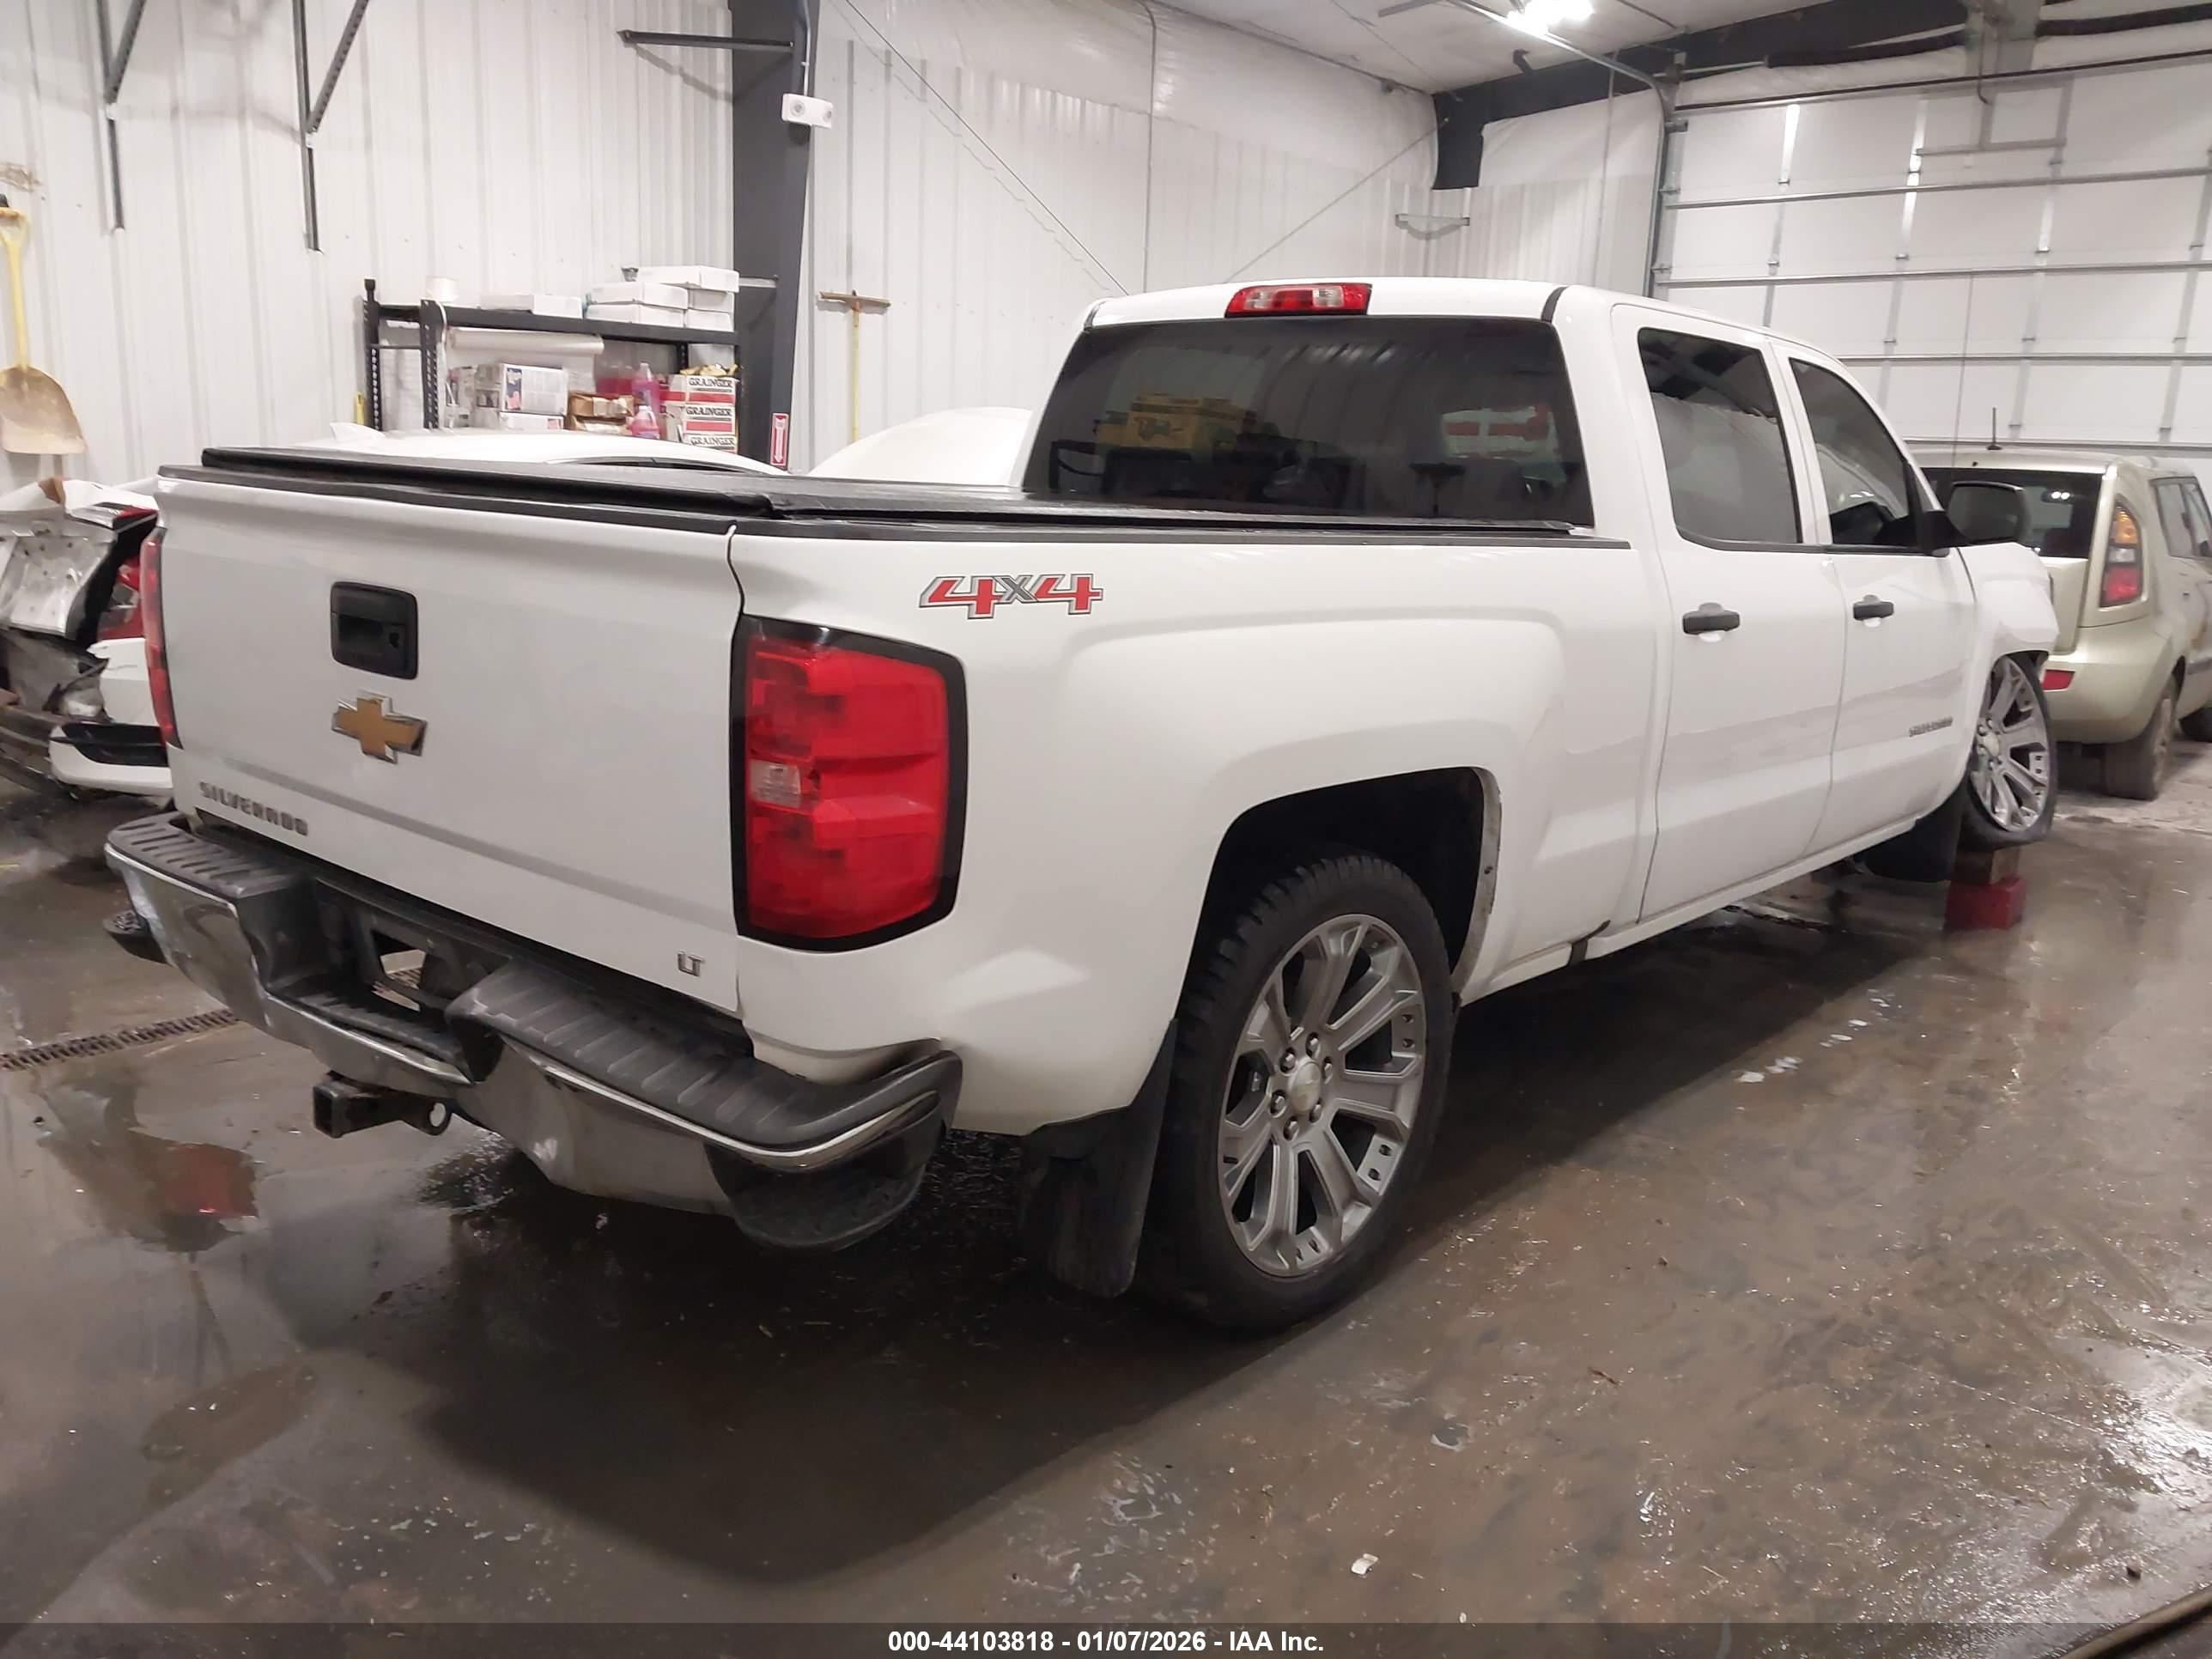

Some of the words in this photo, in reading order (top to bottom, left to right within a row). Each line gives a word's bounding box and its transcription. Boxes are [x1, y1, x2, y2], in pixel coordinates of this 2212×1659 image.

[688, 377, 733, 388] GRAINGER
[686, 406, 732, 416] GRAINGER
[690, 436, 736, 447] GRAINGER
[199, 781, 308, 837] SILVERADO
[678, 951, 705, 977] LT
